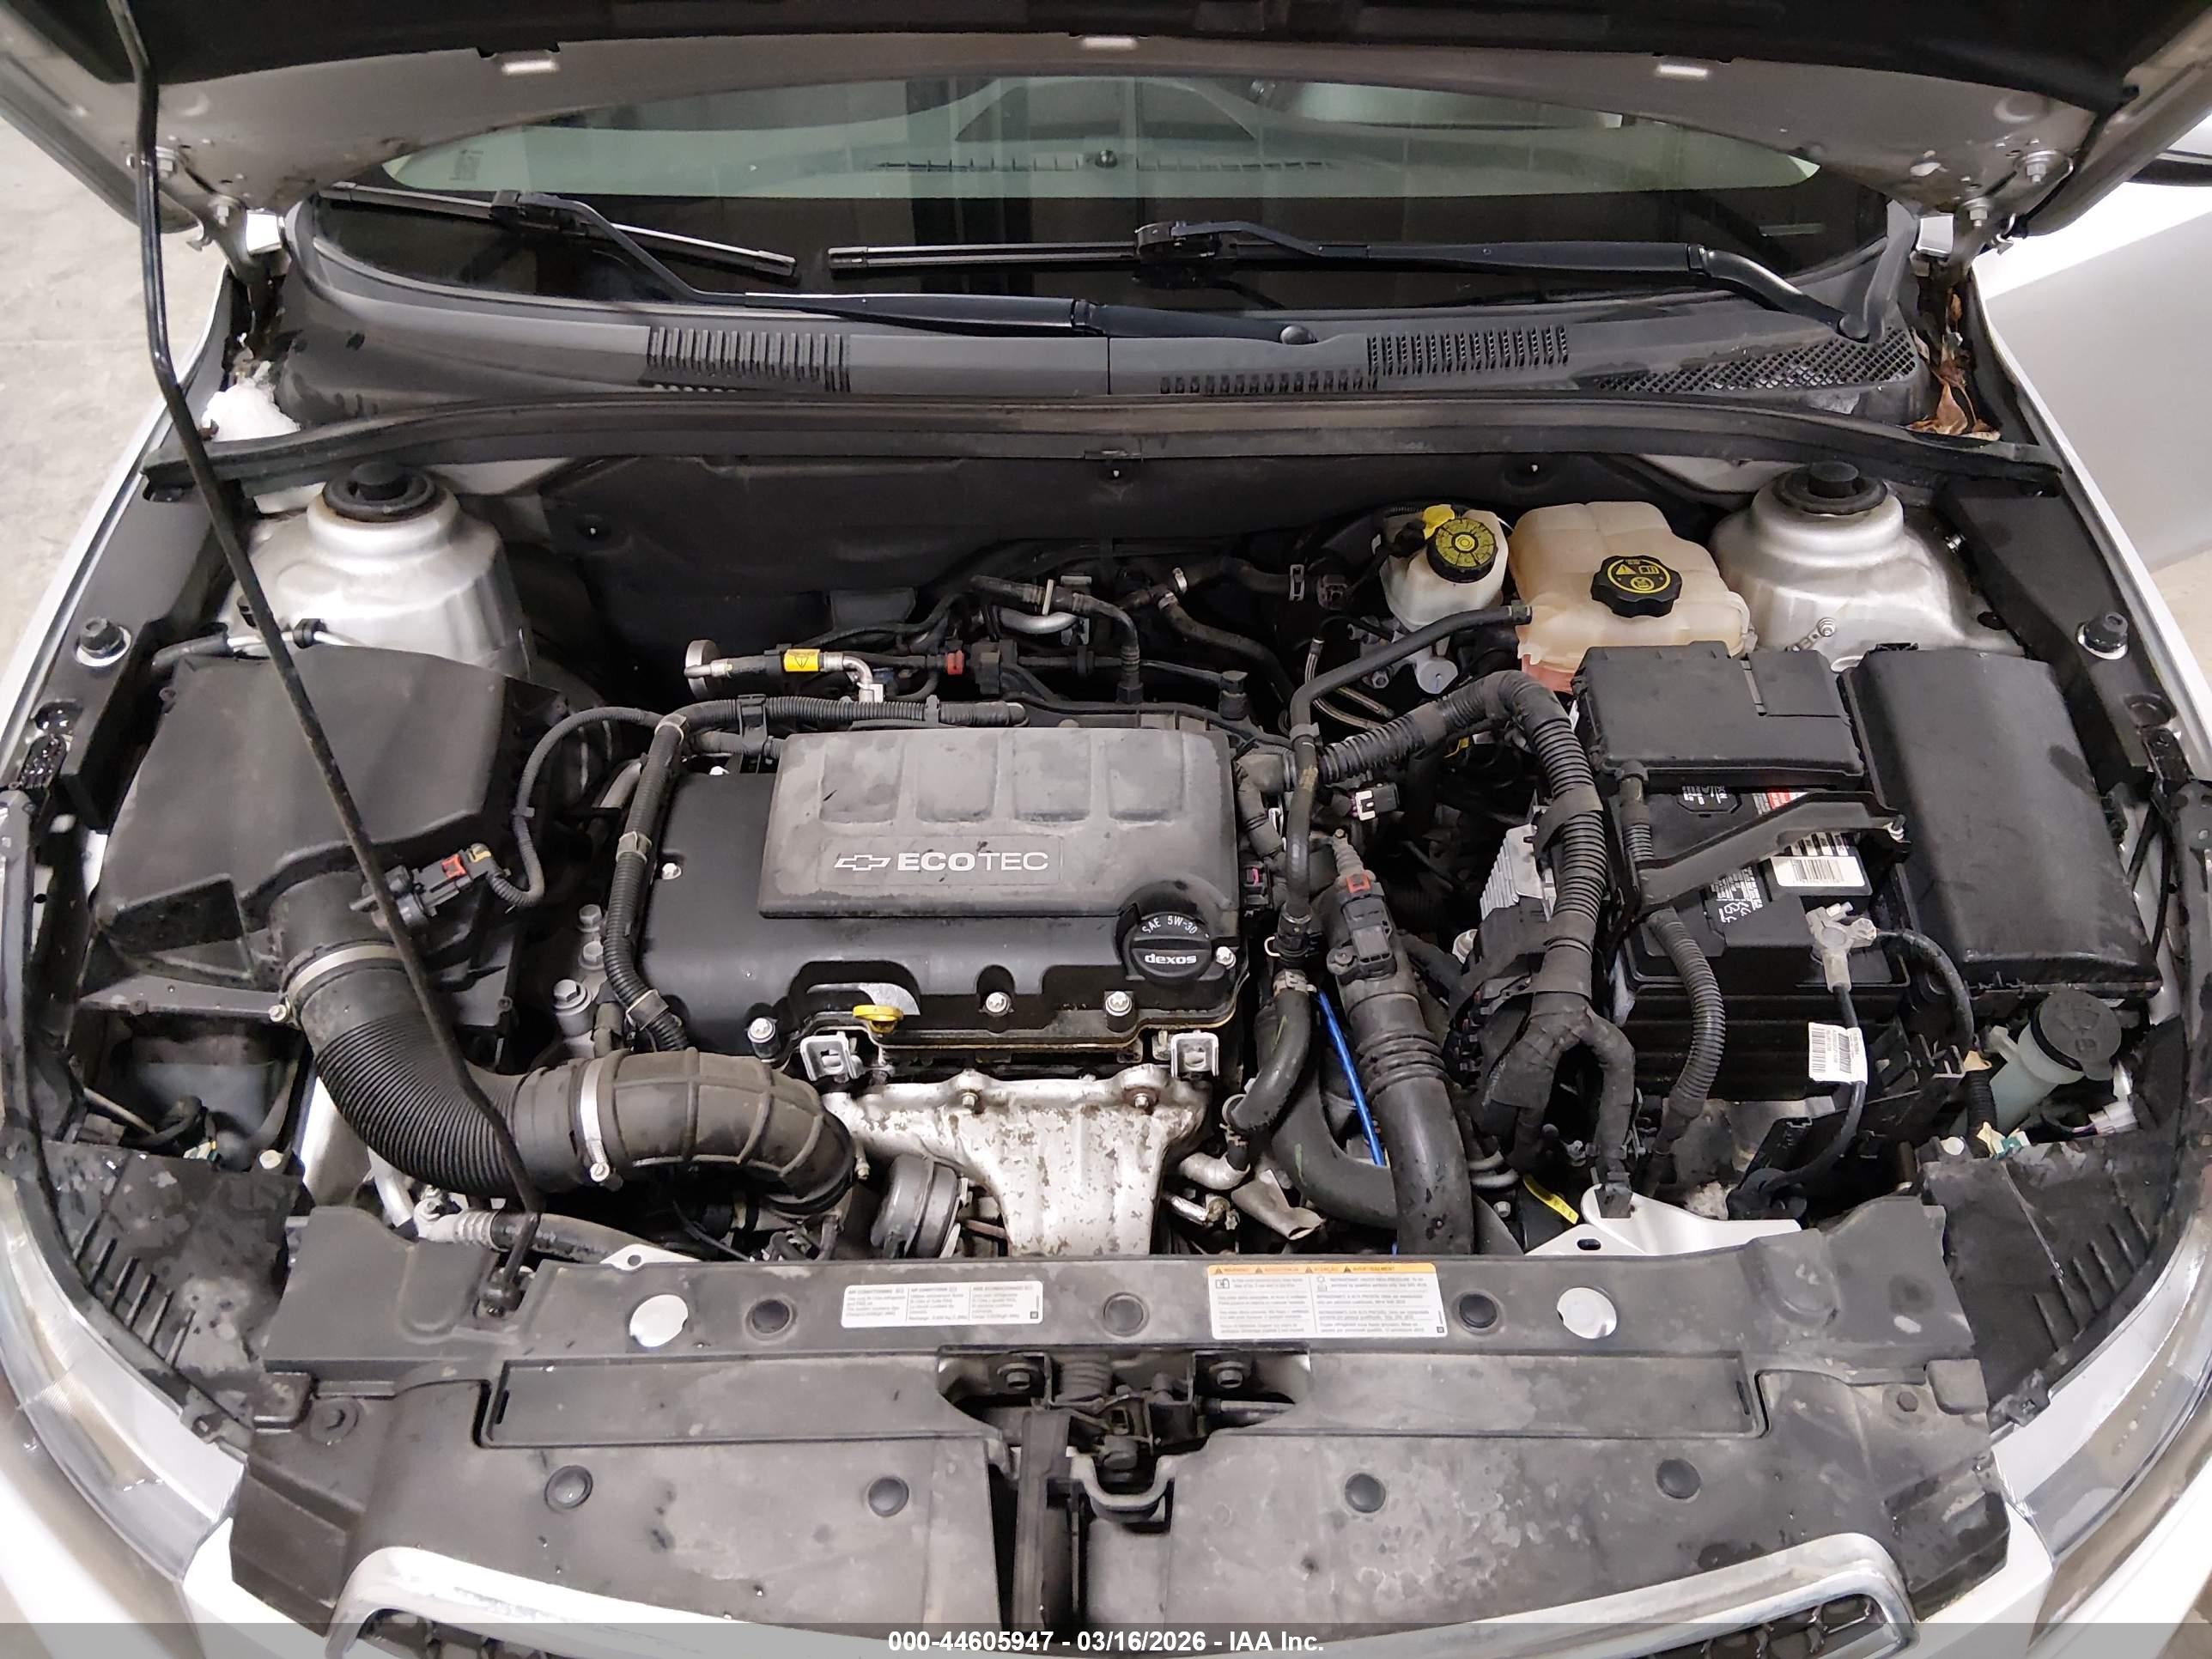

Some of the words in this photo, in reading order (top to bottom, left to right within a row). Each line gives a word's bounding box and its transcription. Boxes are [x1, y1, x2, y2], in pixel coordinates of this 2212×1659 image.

[897, 852, 1048, 872] ECOTEC
[1141, 917, 1162, 933] SAE
[1167, 915, 1198, 934] 5W-30
[1145, 953, 1197, 964] dexos
